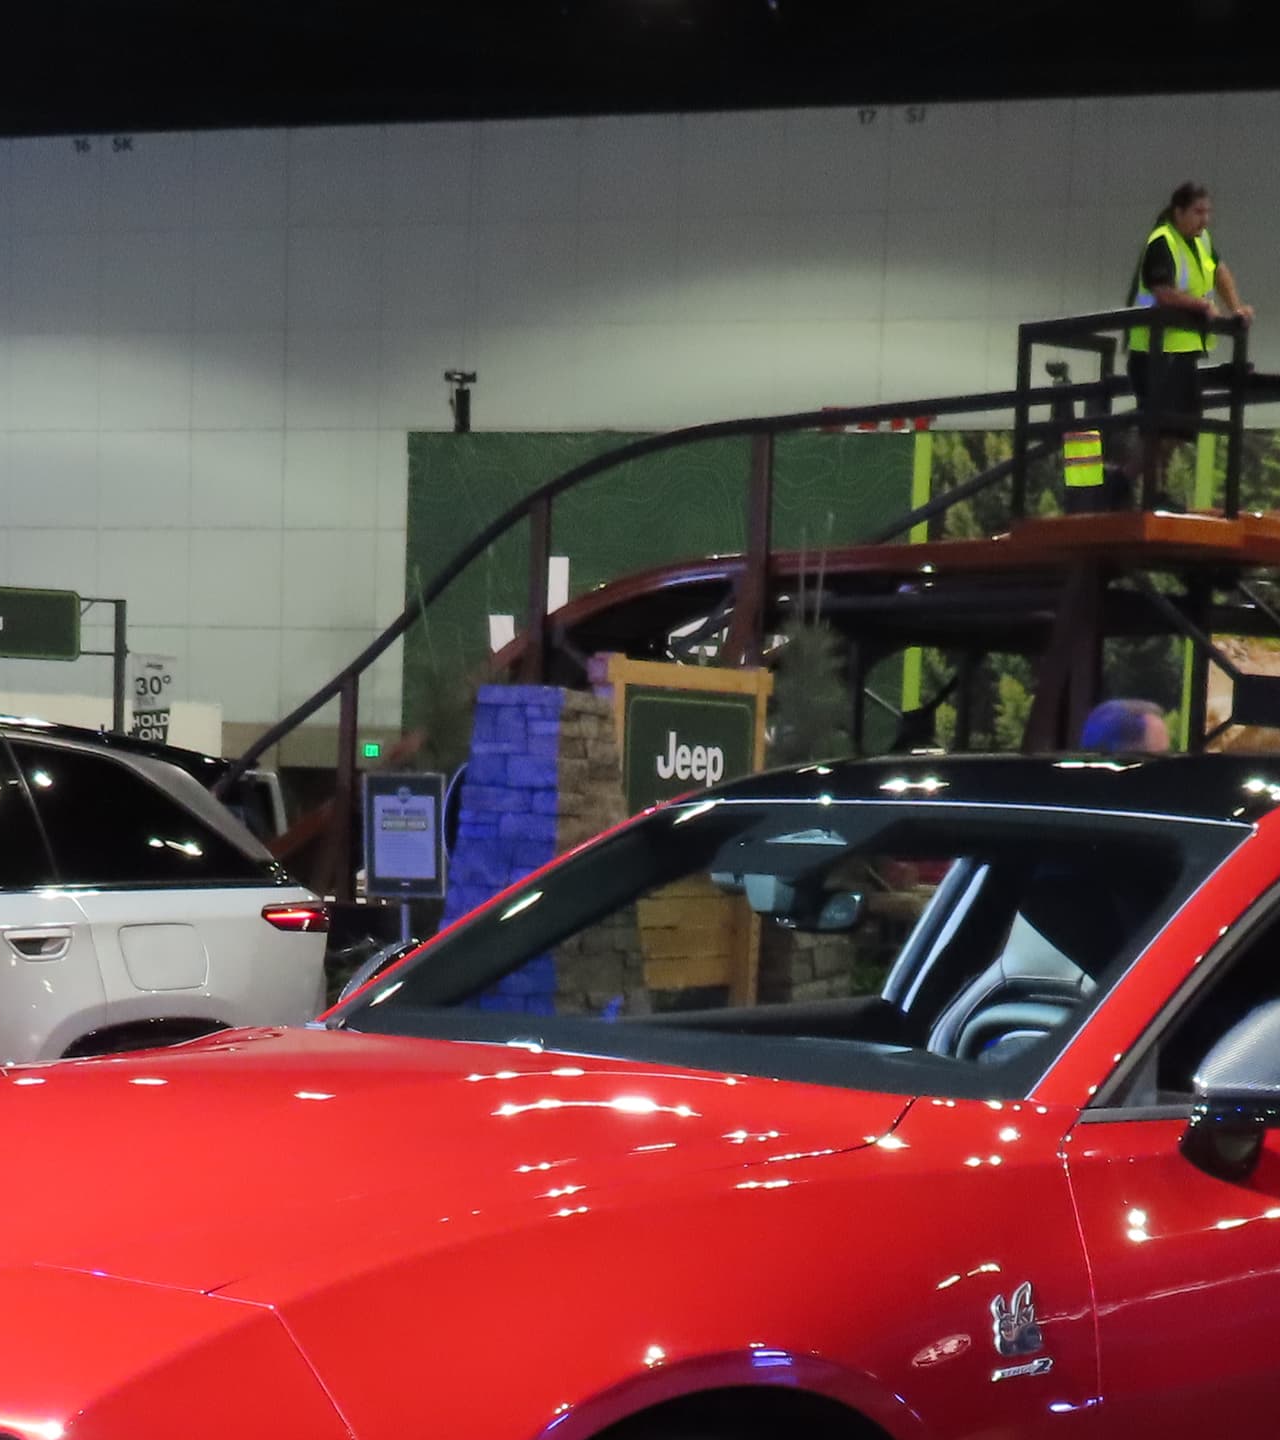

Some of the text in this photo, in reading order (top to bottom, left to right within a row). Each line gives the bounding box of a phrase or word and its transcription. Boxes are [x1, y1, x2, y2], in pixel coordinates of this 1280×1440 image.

[135, 674, 172, 696] 30°
[132, 713, 169, 728] HOLD
[140, 728, 164, 741] ON
[656, 731, 724, 788] Jeep
